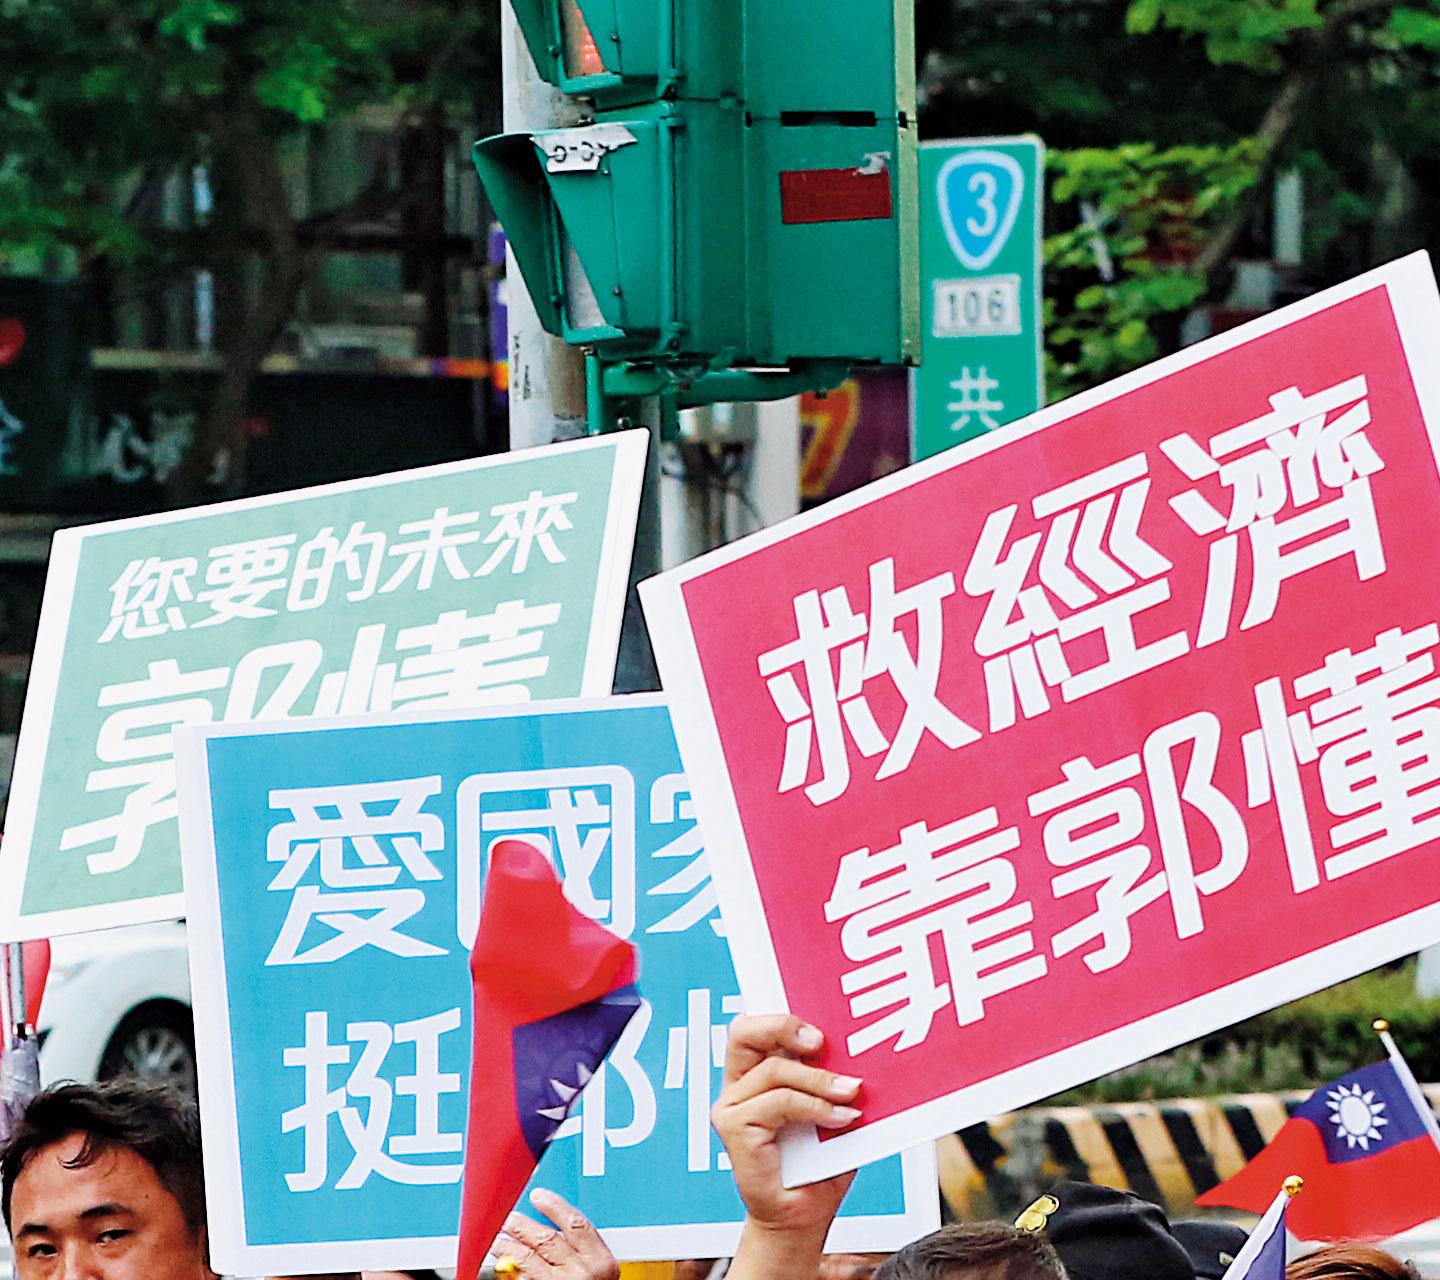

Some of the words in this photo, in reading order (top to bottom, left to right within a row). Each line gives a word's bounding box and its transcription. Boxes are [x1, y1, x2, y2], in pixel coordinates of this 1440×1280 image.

[968, 173, 996, 238] 3
[944, 288, 1007, 327] 106
[947, 367, 1003, 431] 共
[97, 490, 579, 645] 您要的未來
[758, 374, 1386, 805] 救經濟
